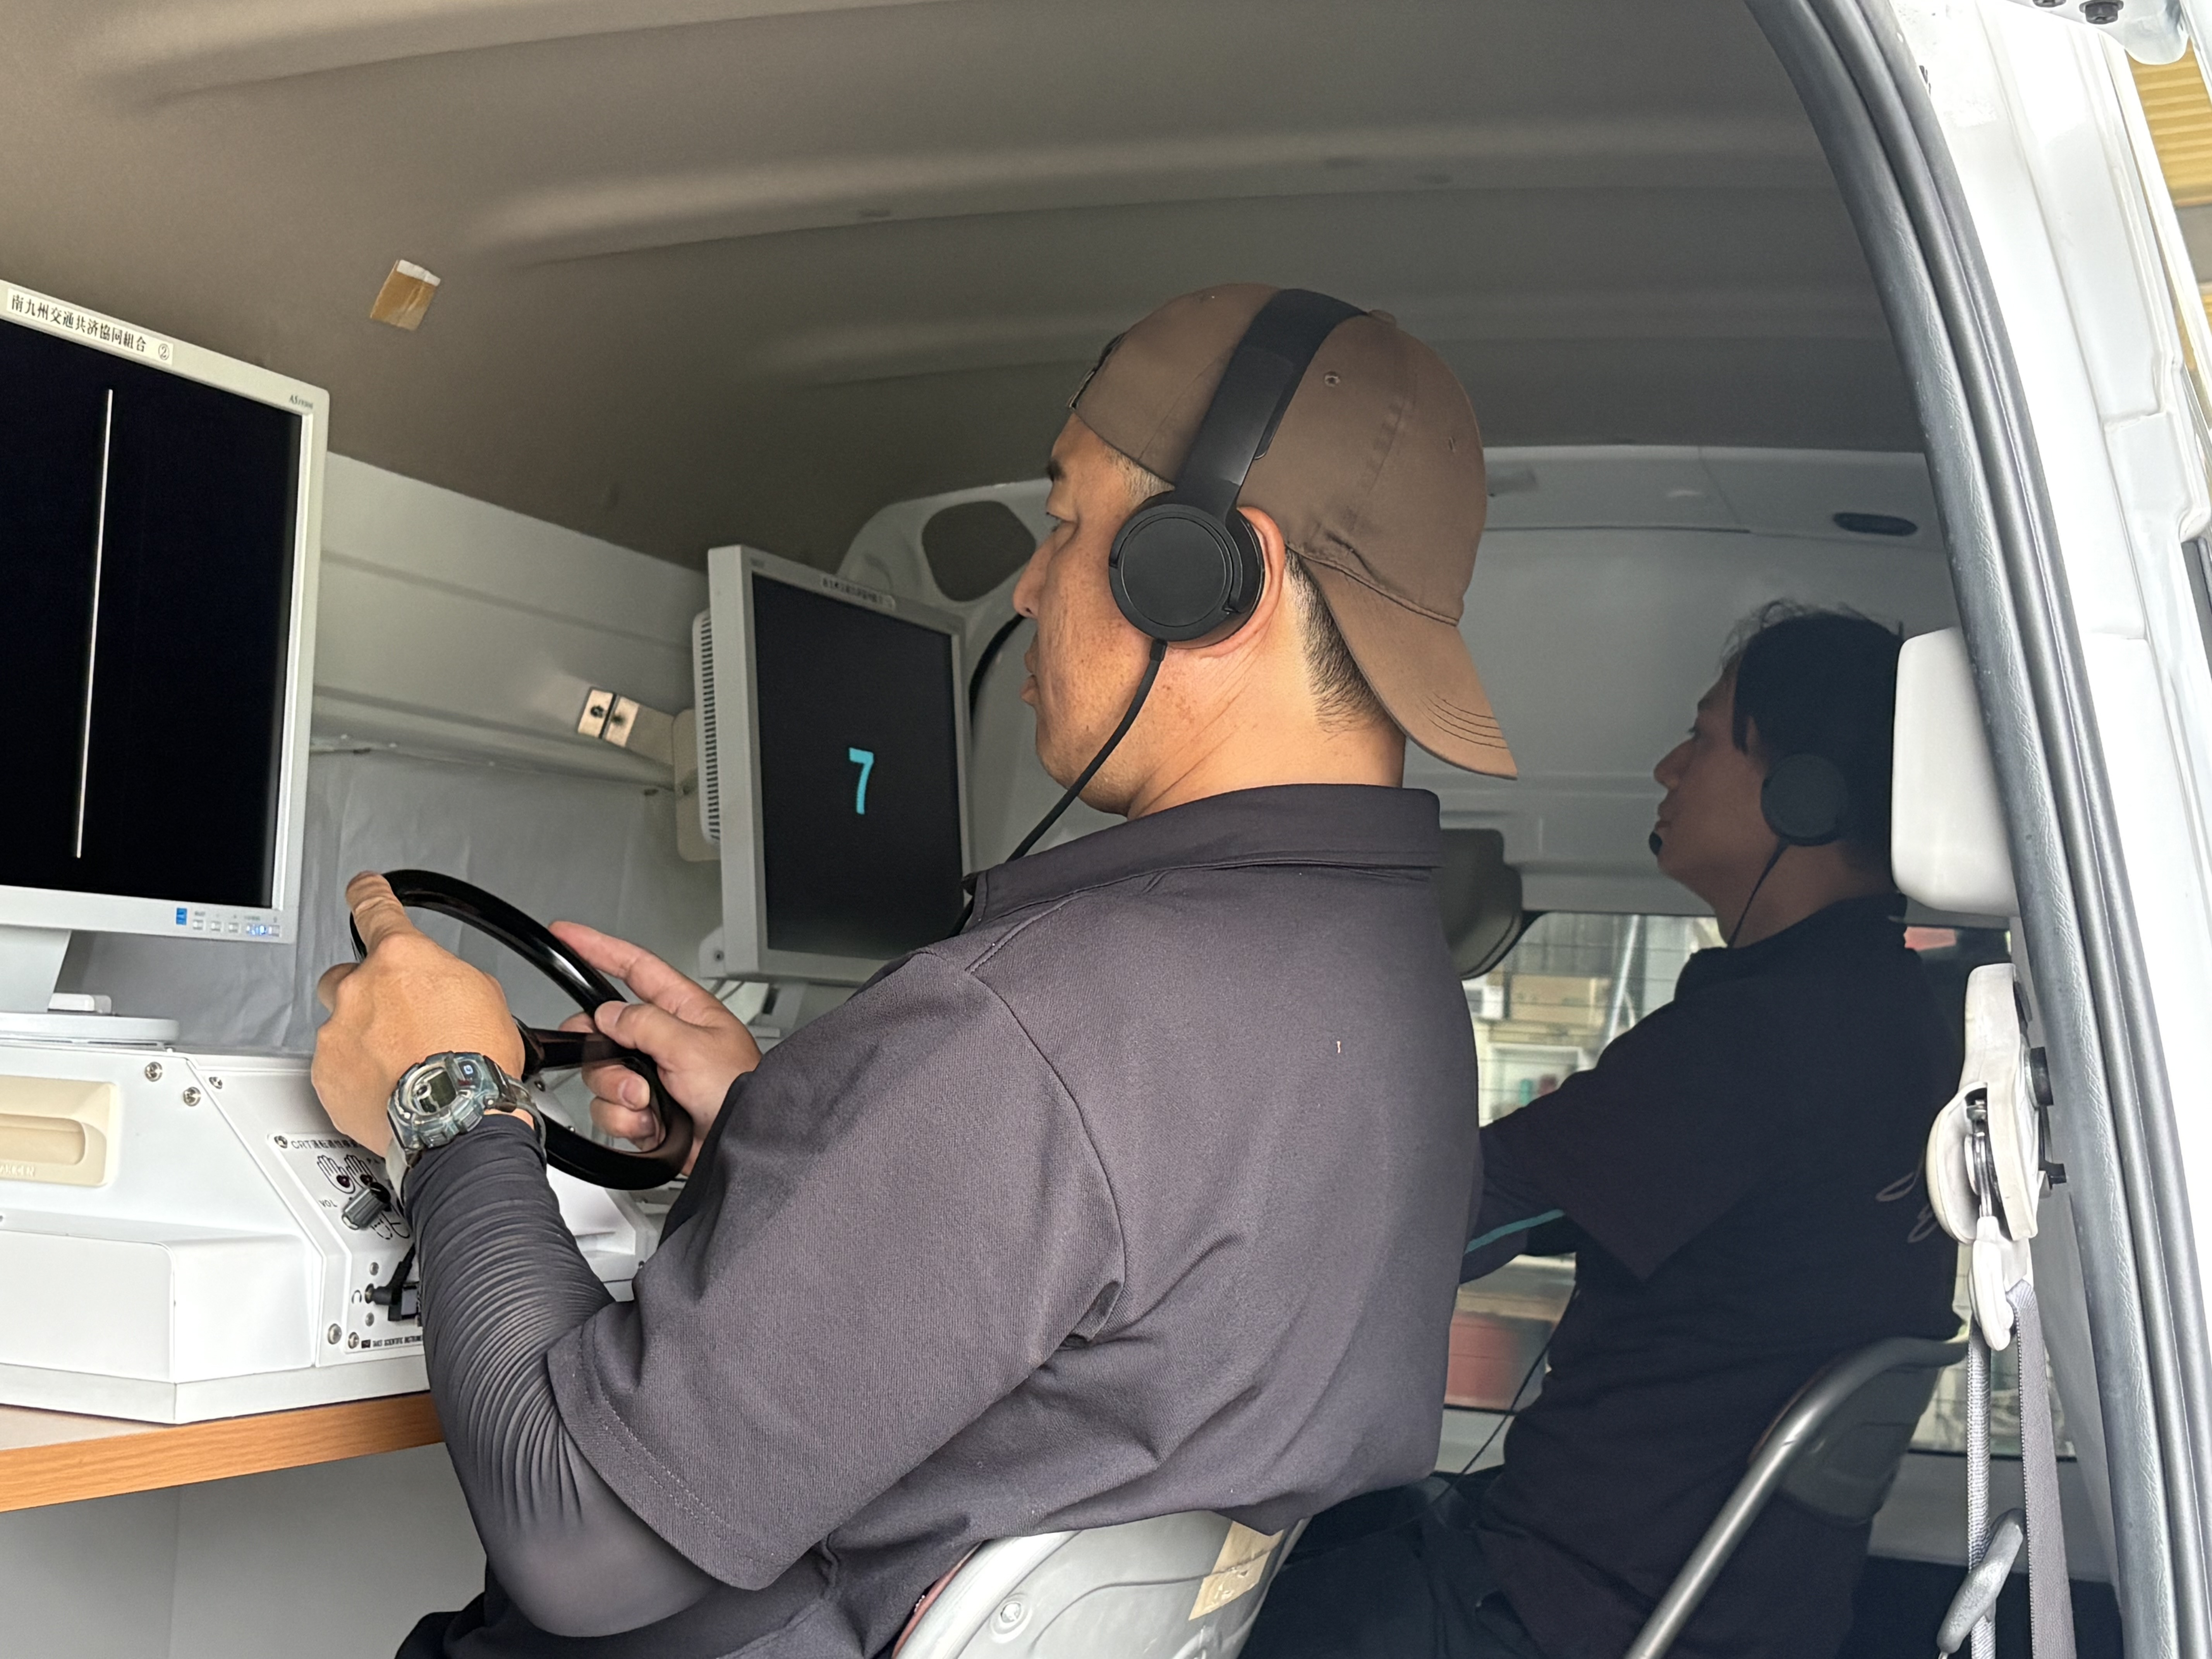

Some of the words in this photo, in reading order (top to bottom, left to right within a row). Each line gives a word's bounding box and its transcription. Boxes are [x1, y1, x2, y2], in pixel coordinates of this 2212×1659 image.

[12, 294, 146, 352] 南九州交通共済協同組合
[849, 747, 874, 815] 7
[318, 1199, 338, 1207] VOL
